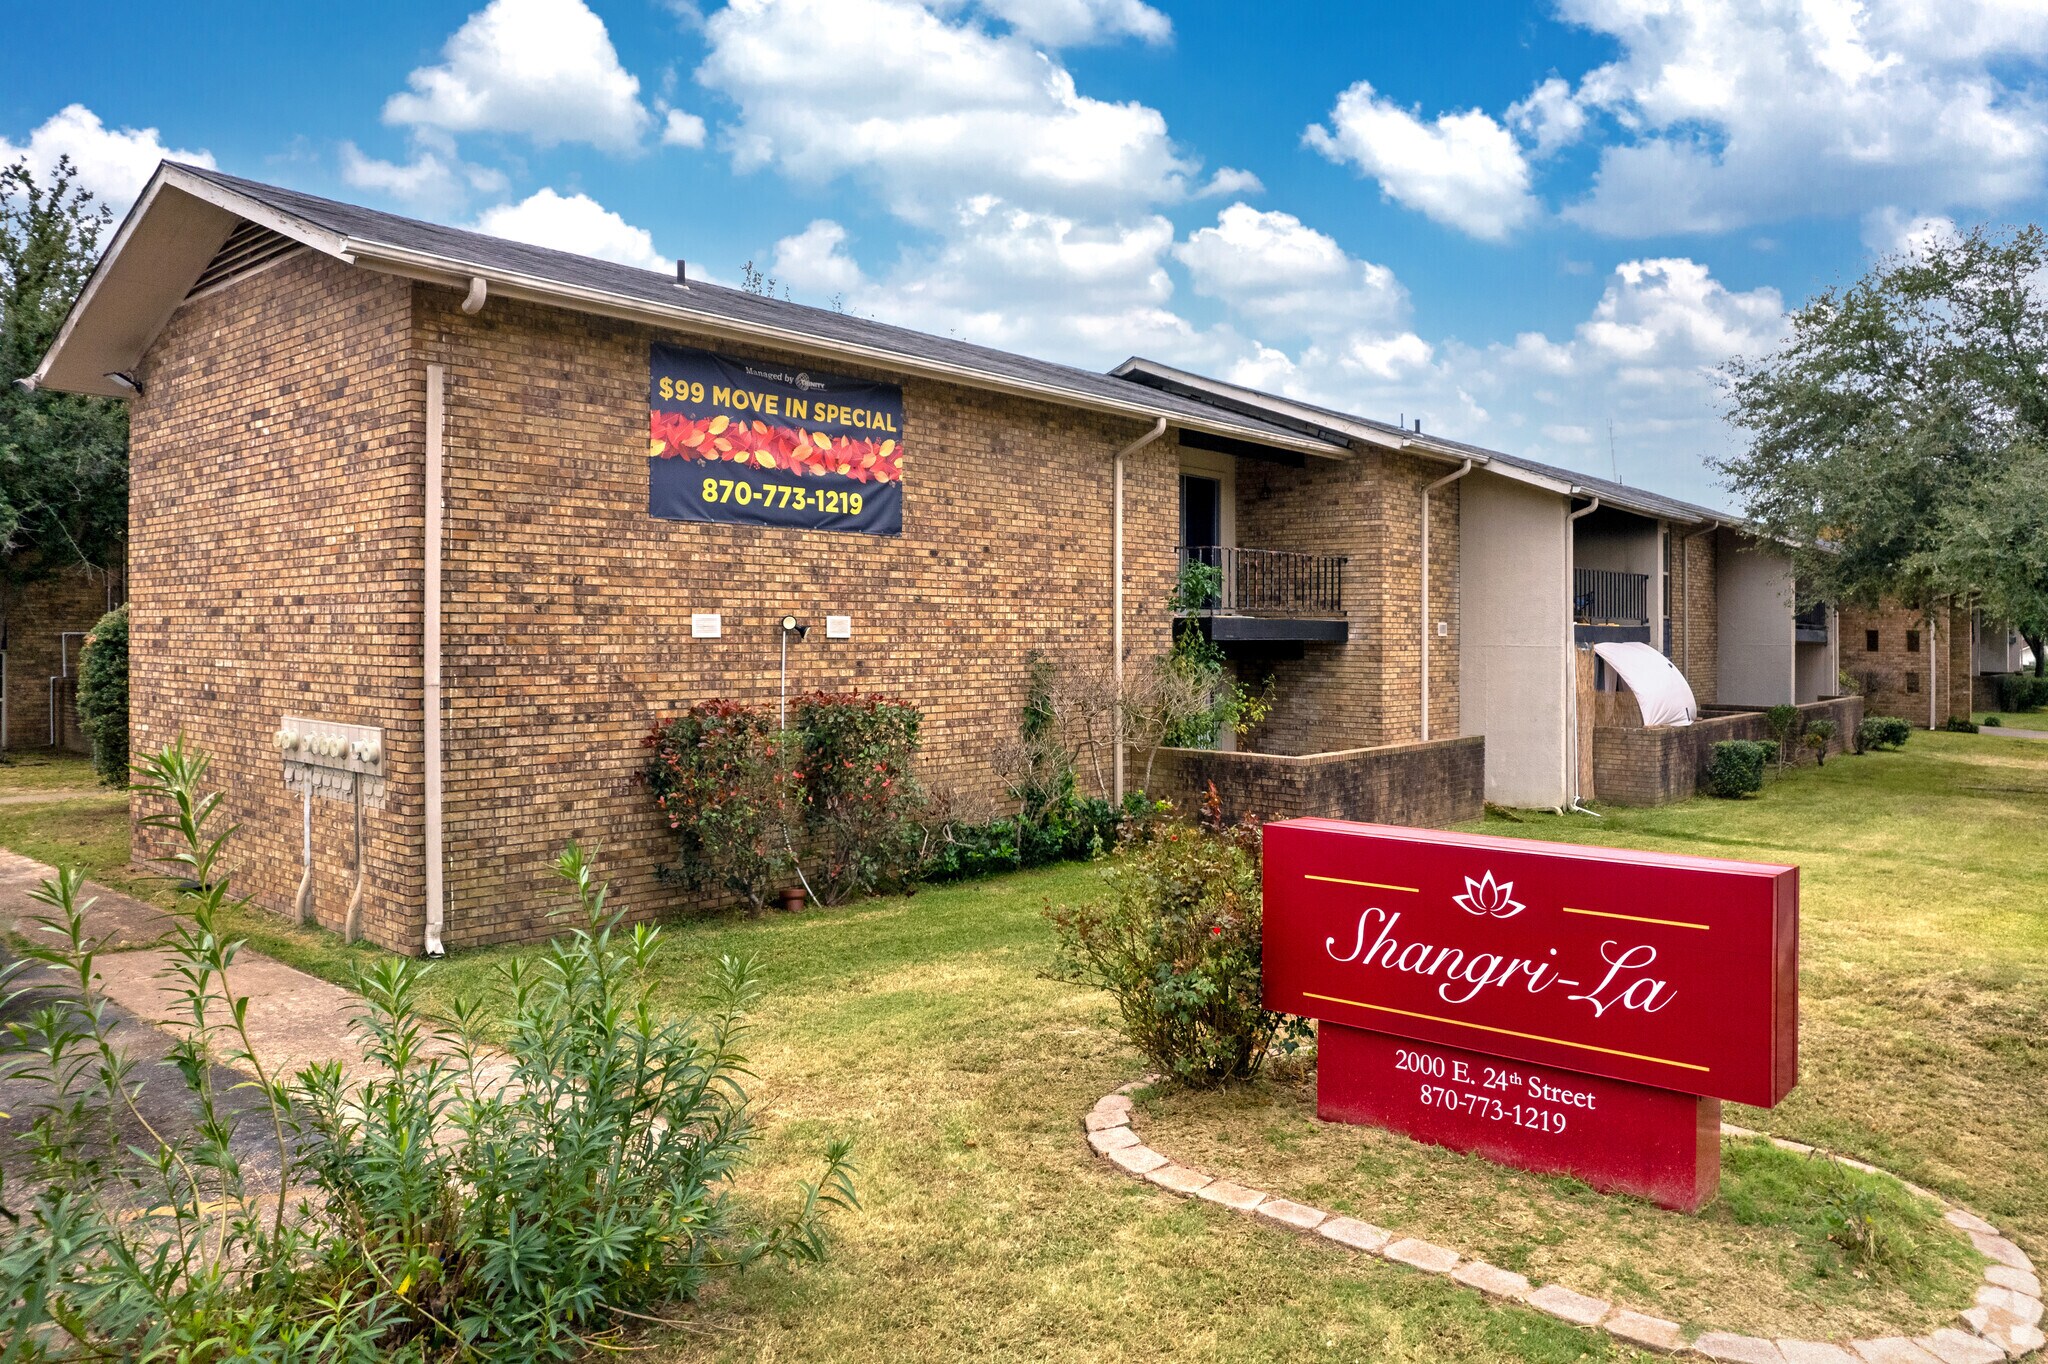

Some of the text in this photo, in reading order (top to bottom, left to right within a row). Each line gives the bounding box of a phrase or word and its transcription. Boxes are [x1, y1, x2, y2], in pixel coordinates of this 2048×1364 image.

[745, 366, 783, 382] Managed
[784, 373, 795, 385] by
[658, 376, 897, 432] $99 MOVE IN SPECIAL
[701, 477, 863, 516] 870-773-1219
[1325, 907, 1678, 1018] Shangri-La
[1395, 1049, 1596, 1111] 2000 E. 24th Street
[1420, 1084, 1567, 1134] 870-773-1219
